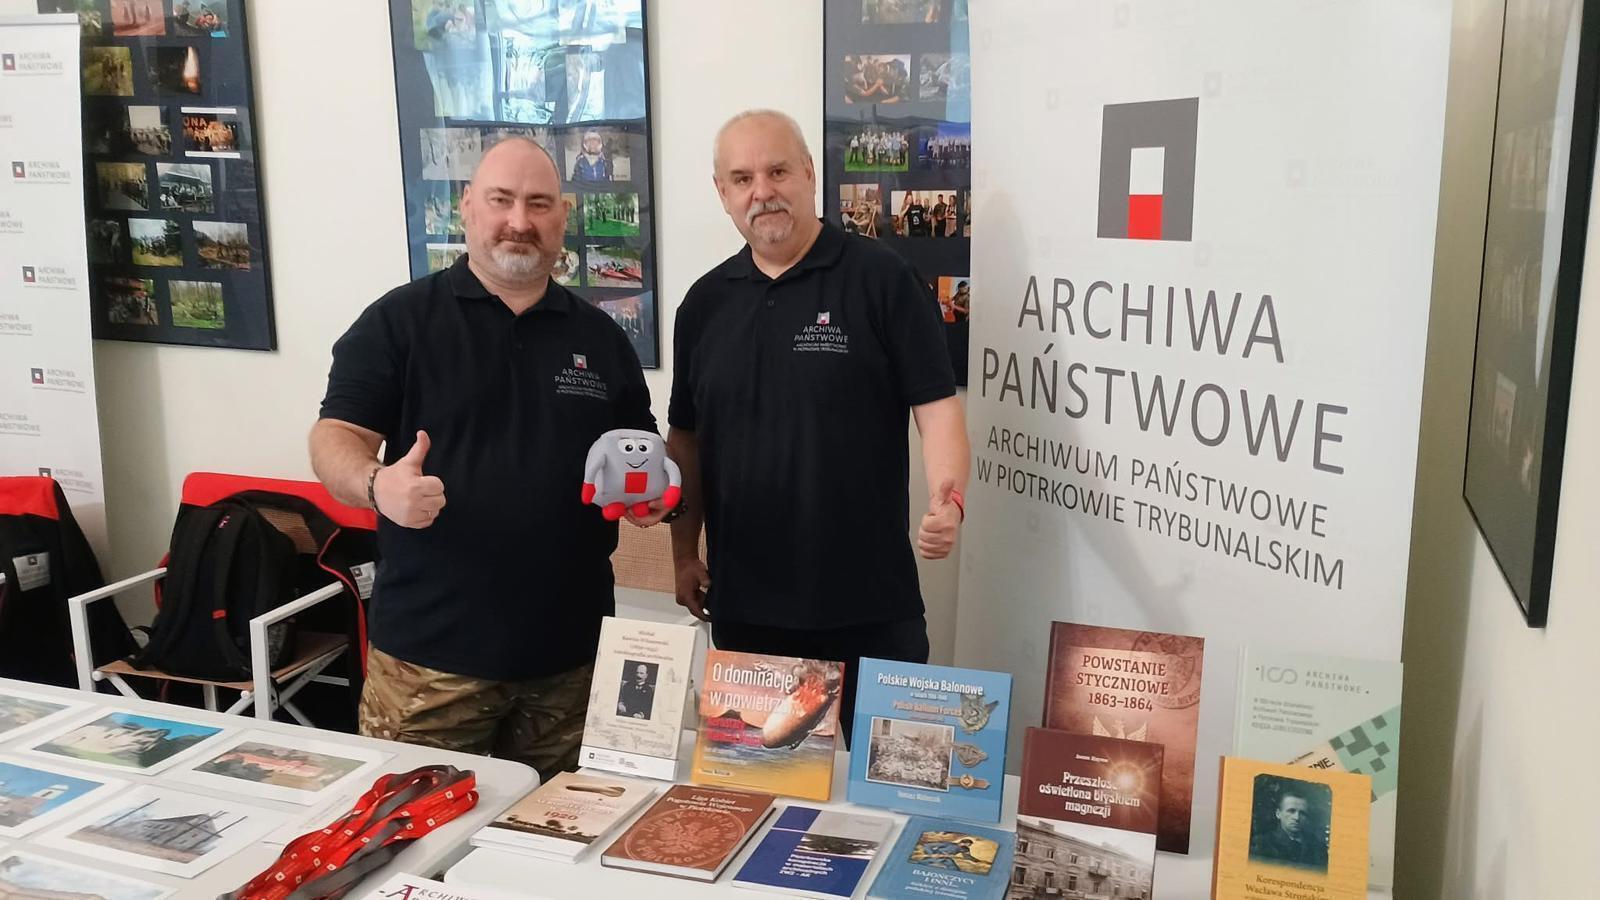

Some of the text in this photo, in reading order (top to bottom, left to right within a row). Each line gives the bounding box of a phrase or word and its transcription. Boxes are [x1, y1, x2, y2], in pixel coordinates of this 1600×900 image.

[1017, 275, 1284, 363] ARCHIWA
[803, 325, 841, 334] ARCHIWA
[562, 368, 600, 380] ARCHIWA
[982, 343, 1348, 475] PAŃSTWOWE
[987, 426, 1328, 538] ARCHIWUM PAŃSTWOWE
[977, 457, 1343, 590] W PIOTRKOWIE TRYBUNALSKIM
[1082, 655, 1167, 676] POWSTANIE
[713, 663, 794, 694] O dominację
[877, 672, 984, 696] Polskie Wojska Balonowe
[1076, 672, 1169, 695] STYCZNIOWE
[1306, 670, 1350, 682] ARCHIWA
[710, 691, 722, 706] w
[1039, 783, 1140, 807] oświetlona błyskiem
[544, 811, 578, 820] 1920
[1065, 801, 1111, 818] magnezji
[386, 884, 474, 900] ARCHIW
[1245, 883, 1283, 897] Wacława
[1256, 874, 1325, 894] Korespondencja
